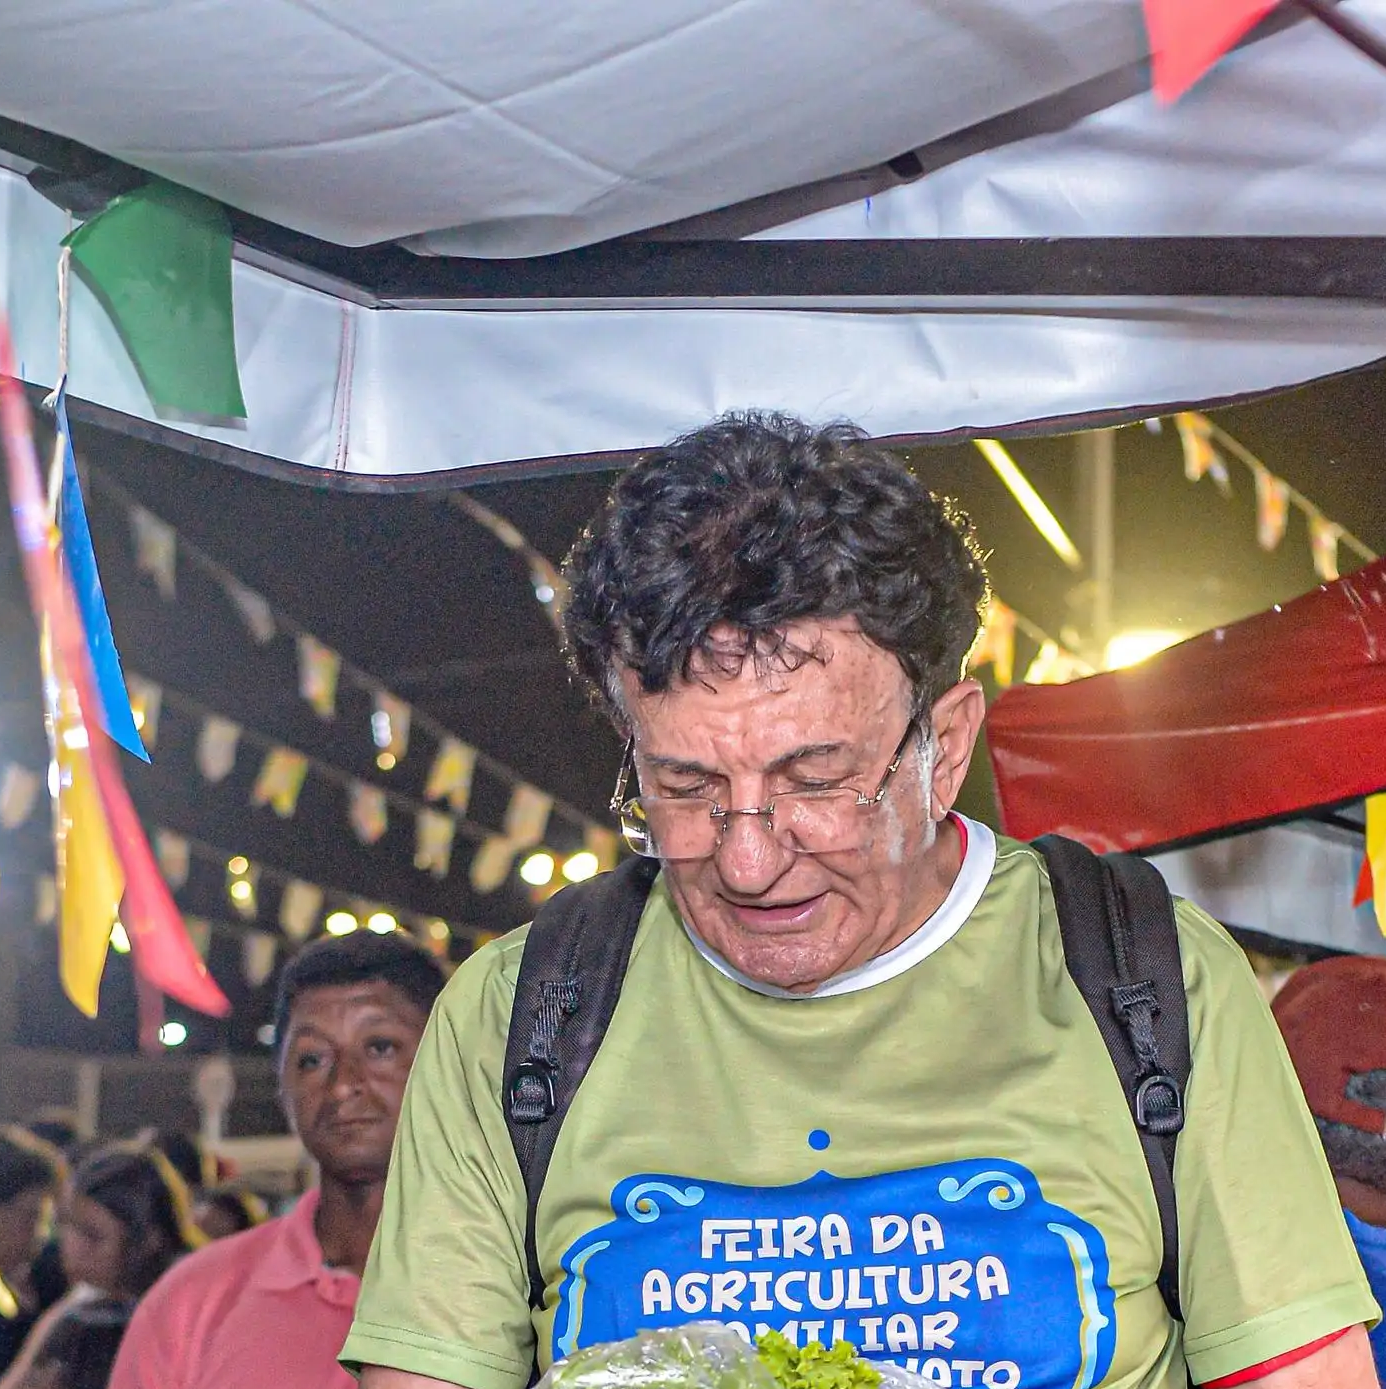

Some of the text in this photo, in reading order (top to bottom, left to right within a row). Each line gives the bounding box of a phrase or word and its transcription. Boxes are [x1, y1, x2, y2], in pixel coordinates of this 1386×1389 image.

[700, 1213, 945, 1262] FEIRA DA
[641, 1256, 1011, 1315] AGRICULTURA
[724, 1311, 960, 1353] AMILIAR
